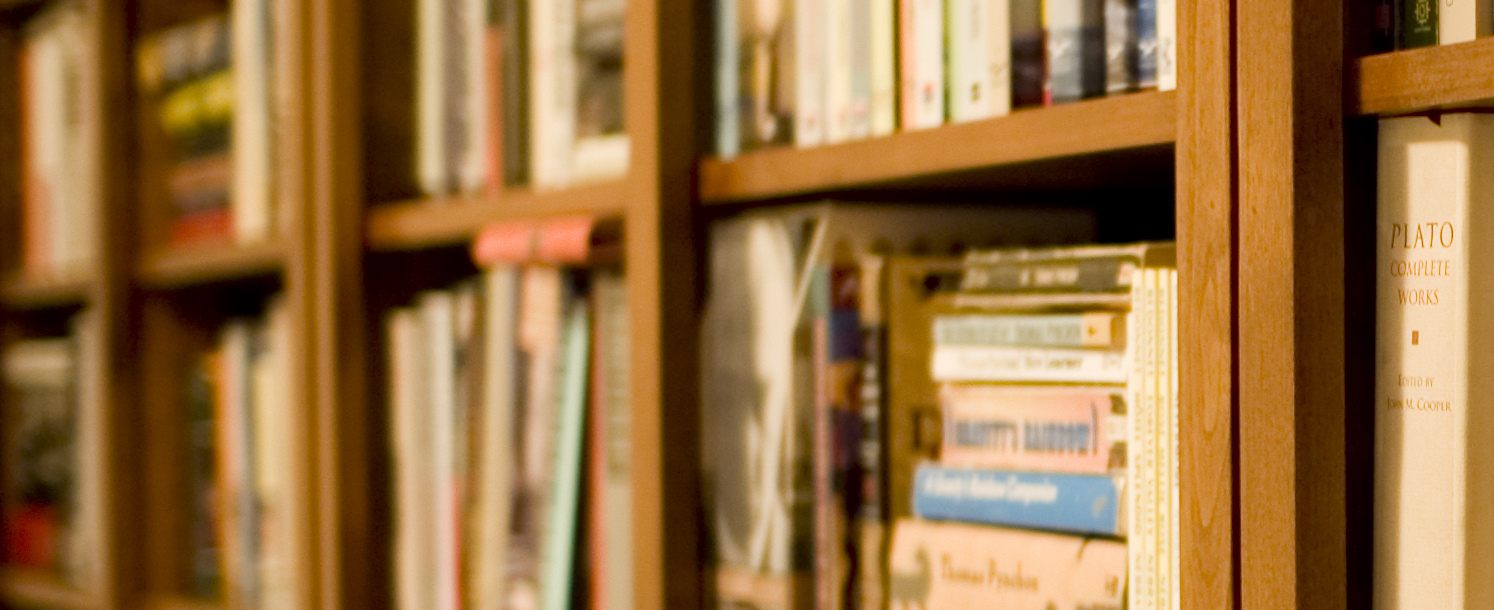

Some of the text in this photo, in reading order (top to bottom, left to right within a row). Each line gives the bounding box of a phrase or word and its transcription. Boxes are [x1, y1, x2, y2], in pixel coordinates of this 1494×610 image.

[1390, 222, 1454, 249] PLATO
[1390, 259, 1450, 277] COMPLETE
[1398, 289, 1439, 306] WORKS
